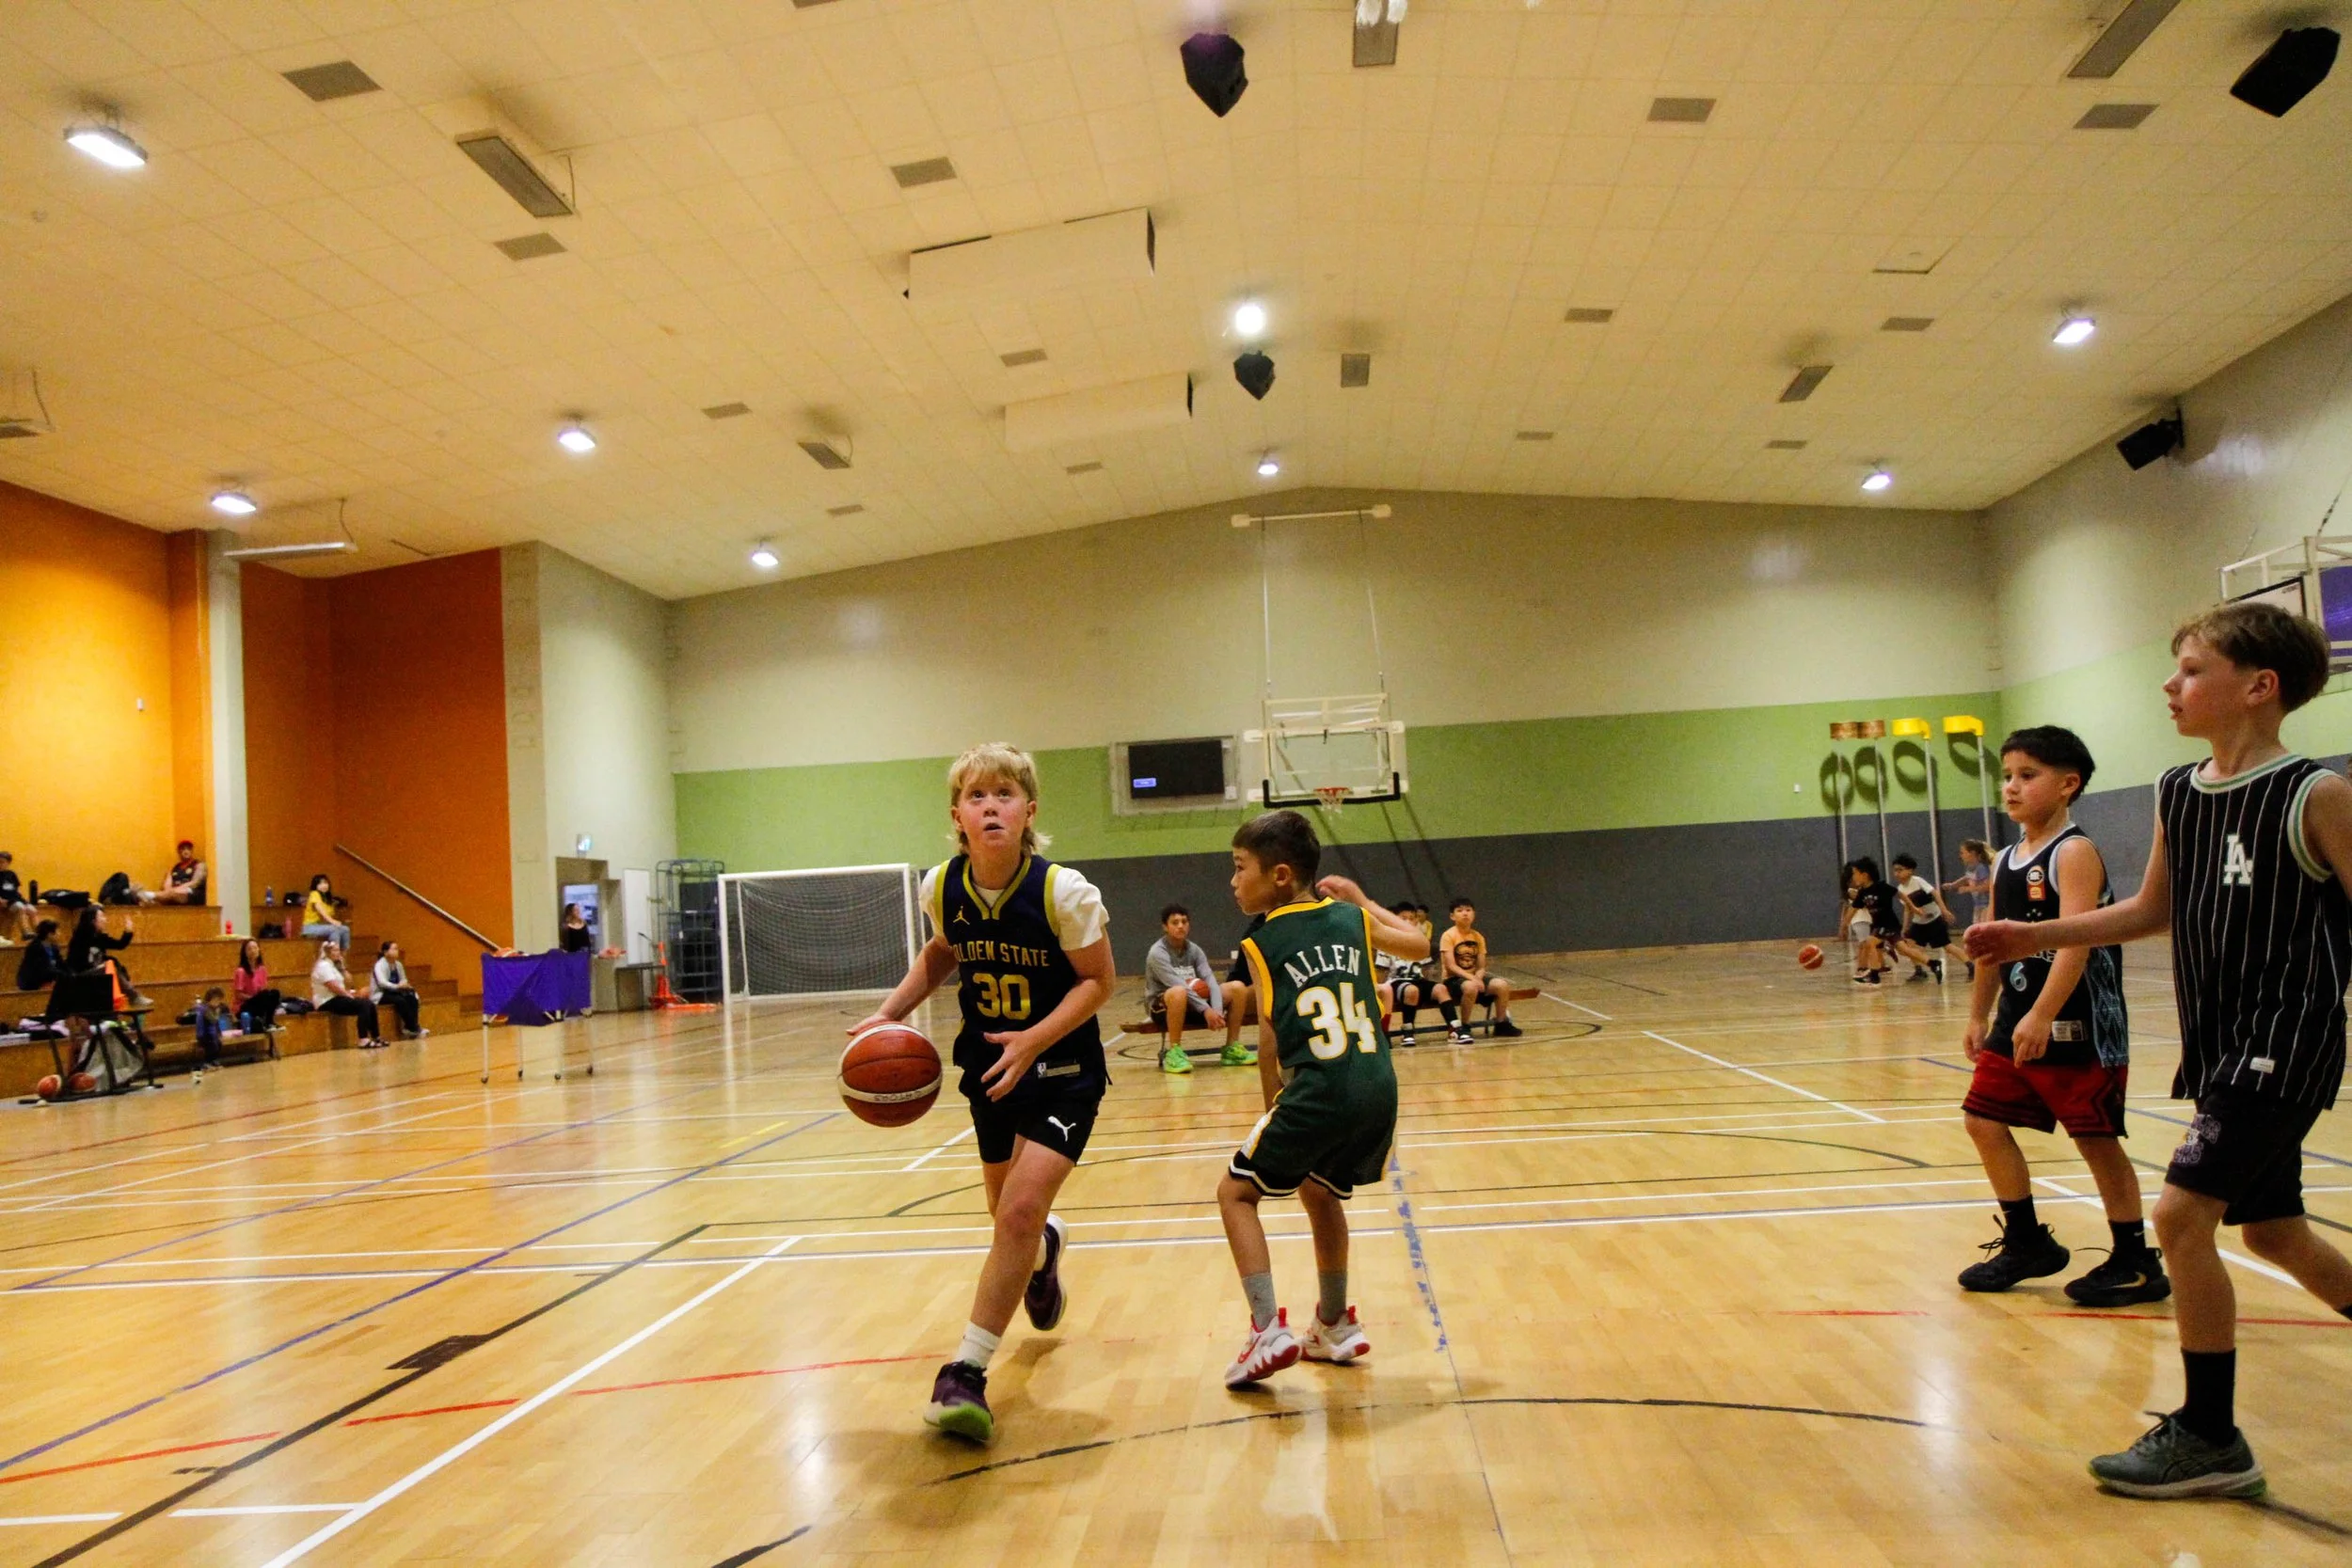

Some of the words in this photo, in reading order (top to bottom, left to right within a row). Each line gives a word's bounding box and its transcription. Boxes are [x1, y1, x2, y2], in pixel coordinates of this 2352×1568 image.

[2223, 834, 2253, 885] LA
[949, 941, 995, 962] OLDEN
[999, 942, 1050, 967] STATE
[1283, 944, 1361, 989] ALLEN
[2009, 961, 2027, 992] 6
[972, 973, 1031, 1020] 30
[1295, 982, 1376, 1060] 34
